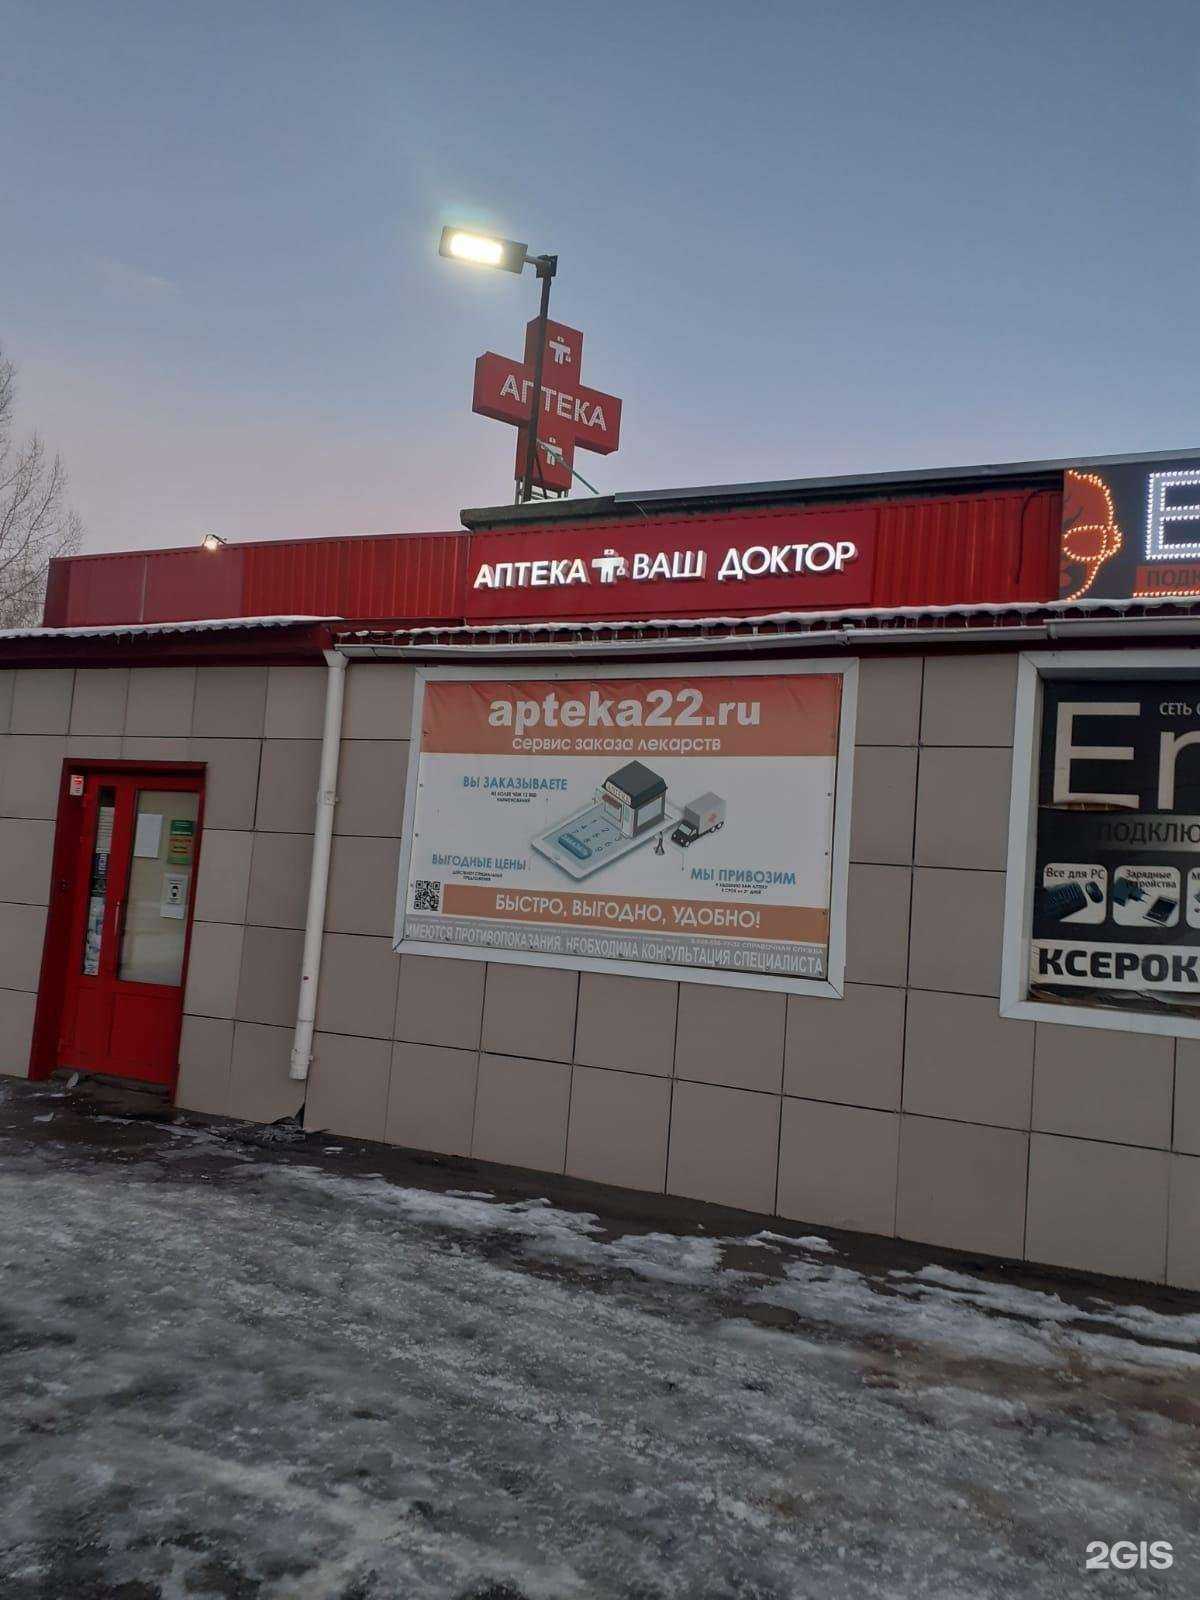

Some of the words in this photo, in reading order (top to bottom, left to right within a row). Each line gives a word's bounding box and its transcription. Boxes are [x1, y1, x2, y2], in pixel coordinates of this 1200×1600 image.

[500, 375, 607, 431] АПТЕКА
[474, 559, 588, 590] АПТЕКА
[633, 550, 706, 579] ВАШ
[717, 541, 857, 581] ДОКТОР
[488, 689, 761, 735] apteka22.ru
[1160, 702, 1192, 715] СЕТЬ
[512, 736, 571, 753] сервис
[574, 736, 634, 751] заказа
[638, 737, 721, 753] лекарств
[463, 776, 480, 788] ВЫ
[483, 776, 568, 790] ЗАКАЗЫВАЕТЕ
[432, 854, 492, 869] ВЫГОДНЫЕ
[495, 858, 526, 871] ЦЕНЫ
[1046, 868, 1065, 878] Все
[1068, 870, 1087, 879] для
[691, 868, 714, 880] МЫ
[719, 869, 796, 885] ПРИВОЗИМ
[496, 895, 567, 917] БЫСТРО,
[572, 899, 666, 924] ВЫГОДНО,
[671, 905, 761, 929] УДОБНО!
[567, 936, 639, 960] НЕОБХОДИМА
[641, 943, 731, 967] КОНСУЛЬТАЦИЯ
[734, 951, 823, 977] СПЕЦИАЛИСТА
[1038, 948, 1200, 983] КСЕРОК
